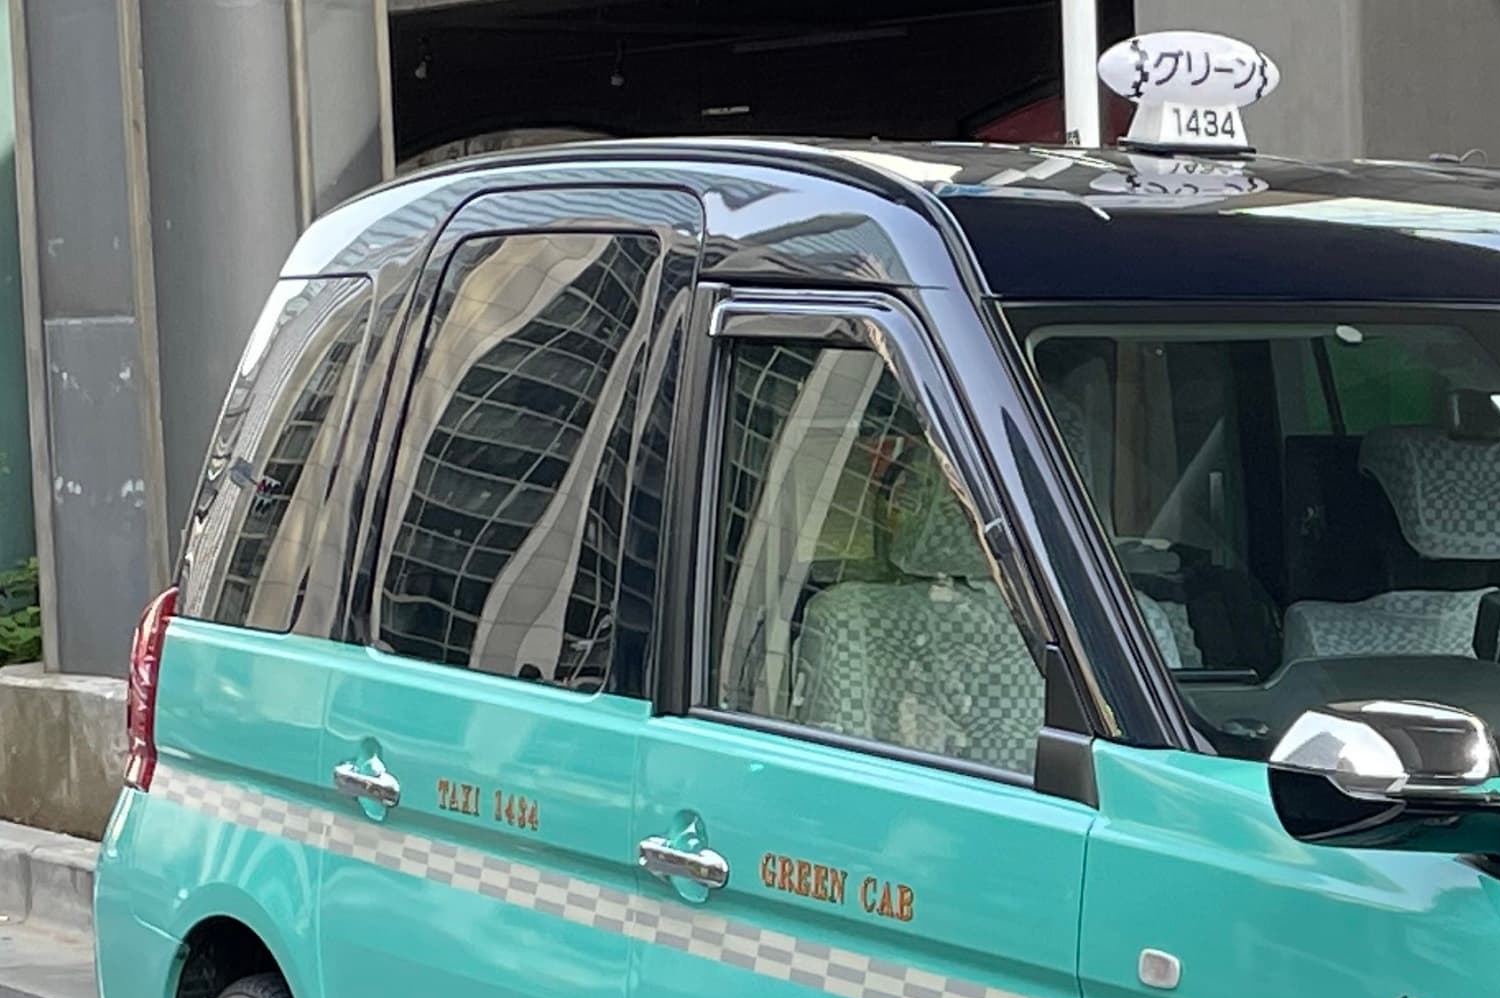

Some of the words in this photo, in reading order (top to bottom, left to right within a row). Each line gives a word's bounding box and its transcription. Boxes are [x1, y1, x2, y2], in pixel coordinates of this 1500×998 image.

[1154, 50, 1256, 89] グリーン
[1173, 108, 1235, 138] 1434
[438, 780, 479, 816] TAXI
[495, 791, 538, 831] 1434
[762, 853, 848, 904] GREEN
[862, 876, 914, 922] CAB
